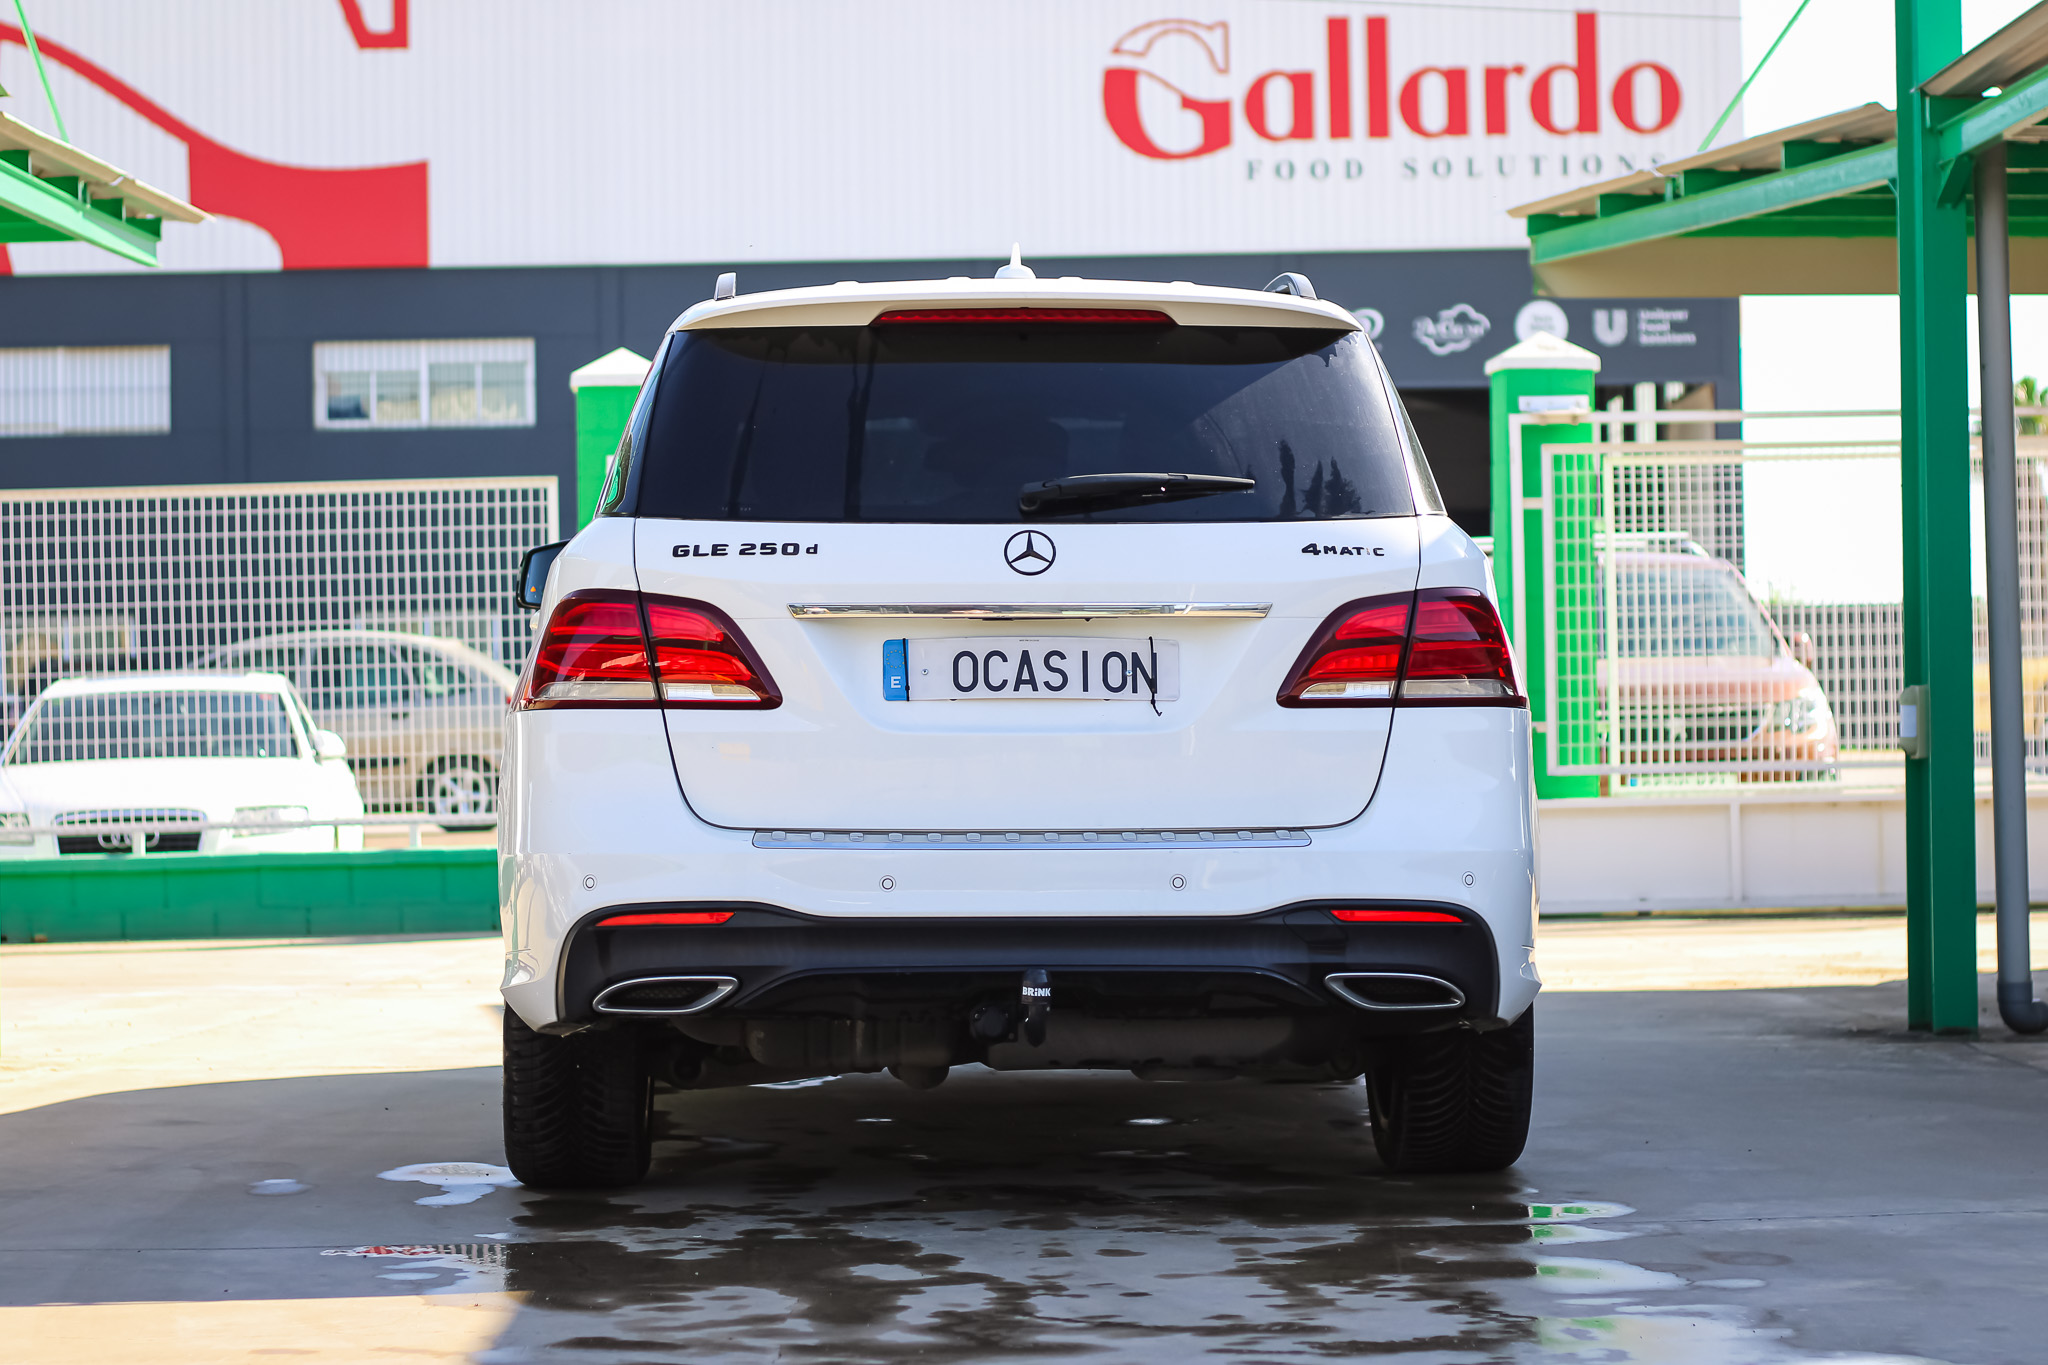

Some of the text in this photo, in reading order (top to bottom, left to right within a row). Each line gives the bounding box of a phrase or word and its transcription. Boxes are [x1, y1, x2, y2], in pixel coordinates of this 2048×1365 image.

[1103, 11, 1682, 161] Gallardo
[1246, 158, 1364, 181] FOOD
[672, 544, 729, 558] GLE
[890, 676, 901, 689] E
[952, 649, 1158, 694] OCASION
